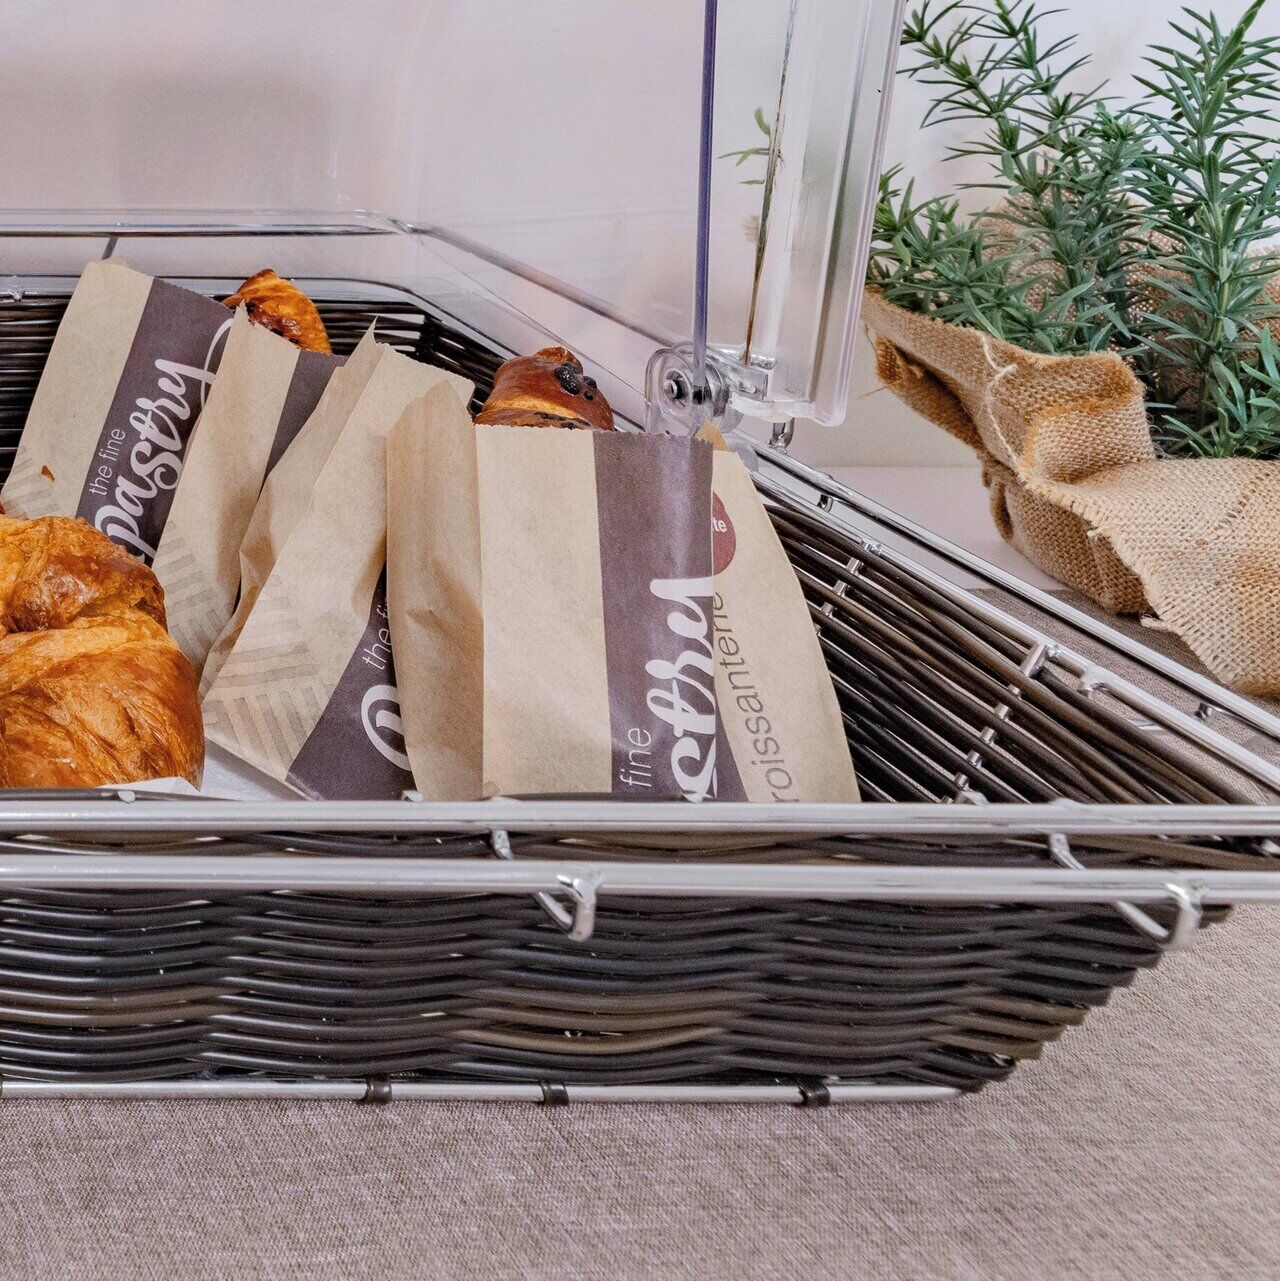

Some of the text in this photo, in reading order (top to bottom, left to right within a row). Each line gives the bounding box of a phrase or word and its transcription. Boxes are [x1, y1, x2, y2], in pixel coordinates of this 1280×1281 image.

[89, 427, 126, 496] the fine
[362, 627, 392, 670] the
[712, 591, 800, 803] roissanterie
[620, 727, 653, 787] fine
